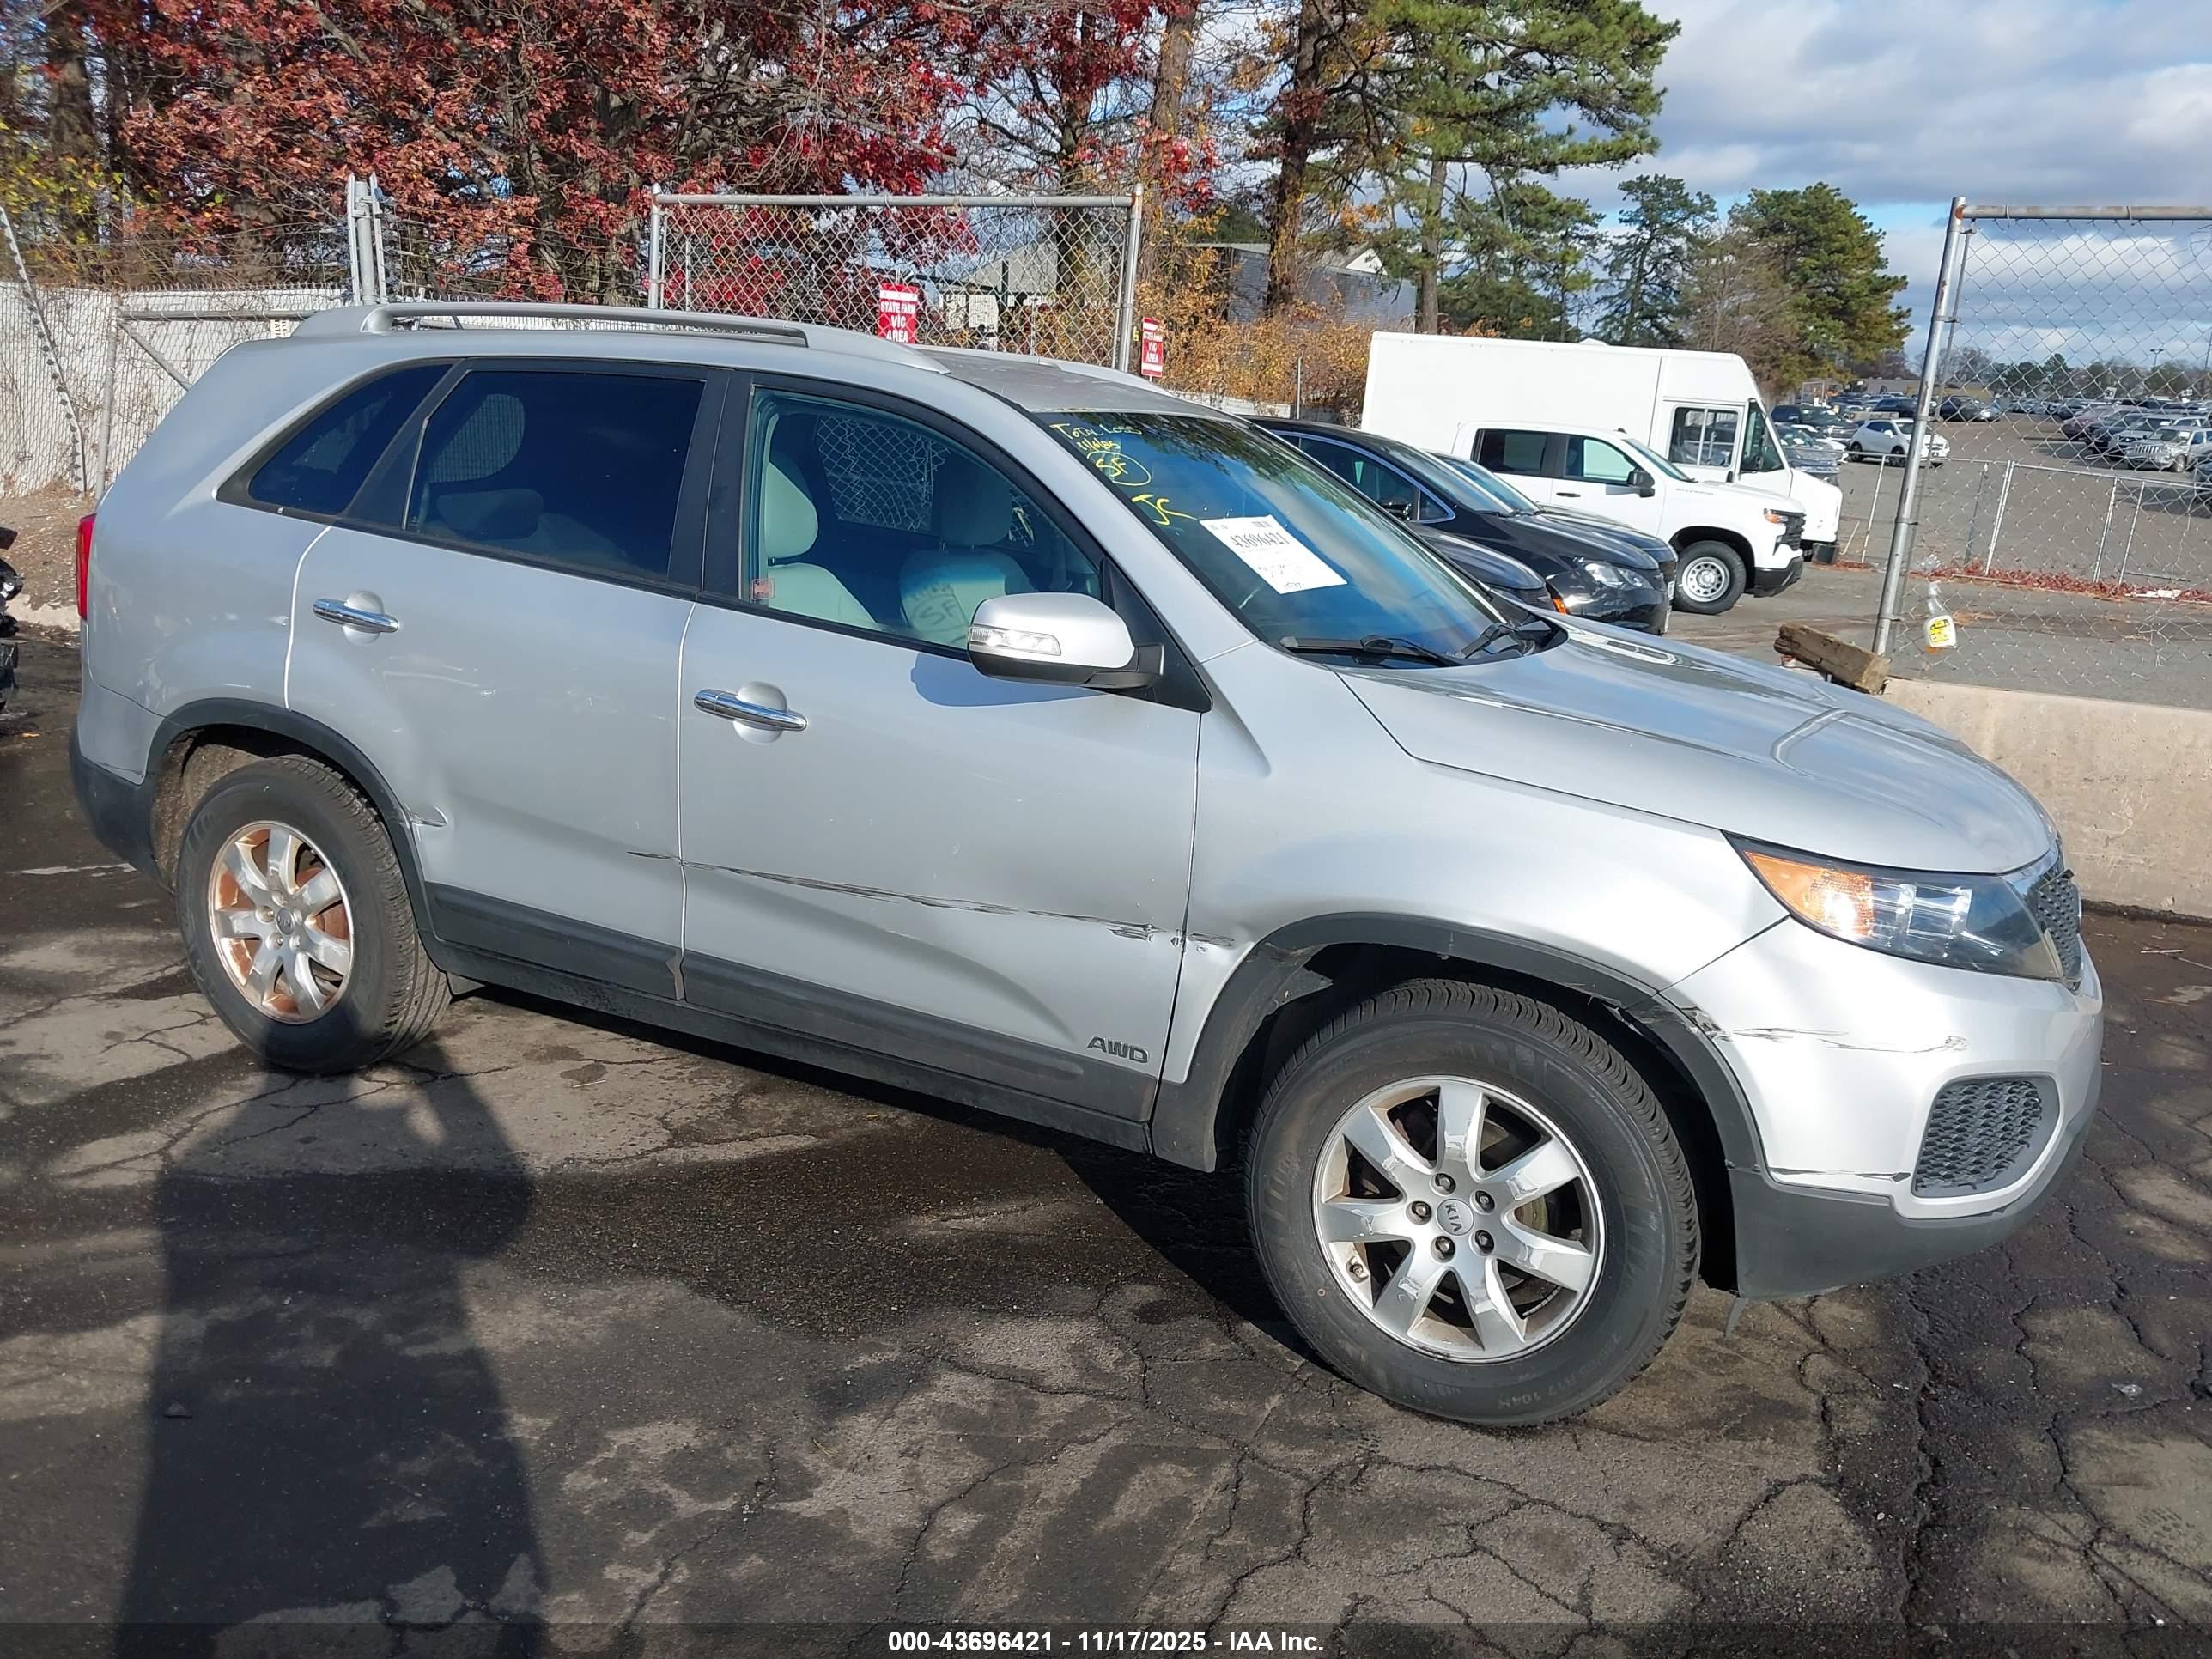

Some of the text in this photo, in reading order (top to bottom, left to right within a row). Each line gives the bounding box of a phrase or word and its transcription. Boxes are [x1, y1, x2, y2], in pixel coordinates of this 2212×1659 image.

[880, 301, 916, 314] STATE FARM
[891, 315, 906, 328] VIC
[886, 329, 908, 343] AREA
[1095, 457, 1129, 477] SF
[1087, 1036, 1151, 1064] AWD
[1444, 1204, 1463, 1232] KIA
